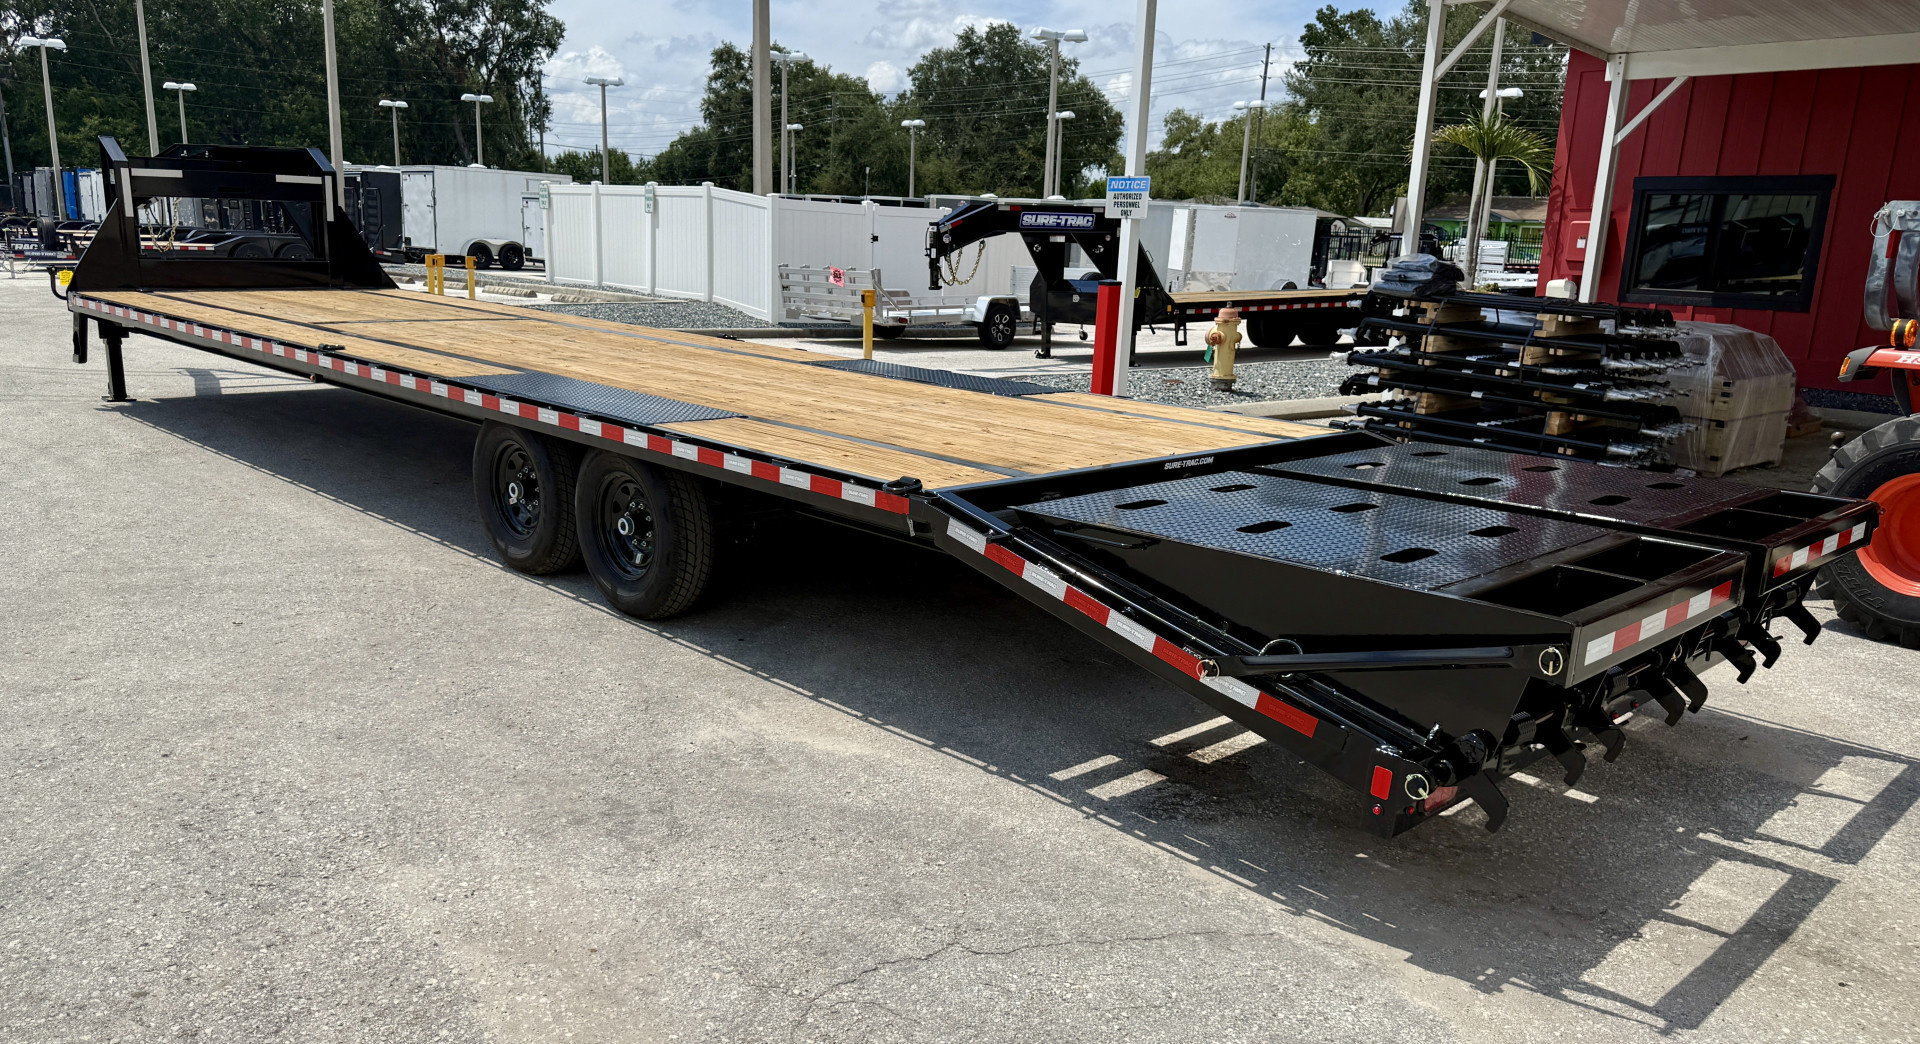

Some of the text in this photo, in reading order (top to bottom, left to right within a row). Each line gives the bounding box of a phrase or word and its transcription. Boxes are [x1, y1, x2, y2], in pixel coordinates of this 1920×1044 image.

[1110, 180, 1147, 189] NOTICE
[1022, 214, 1093, 227] SURE-TRAC
[1164, 456, 1214, 470] SURE-TRAC.COM
[1031, 571, 1057, 589] SURE-TRAC
[1117, 621, 1145, 640] SURE-TRAC
